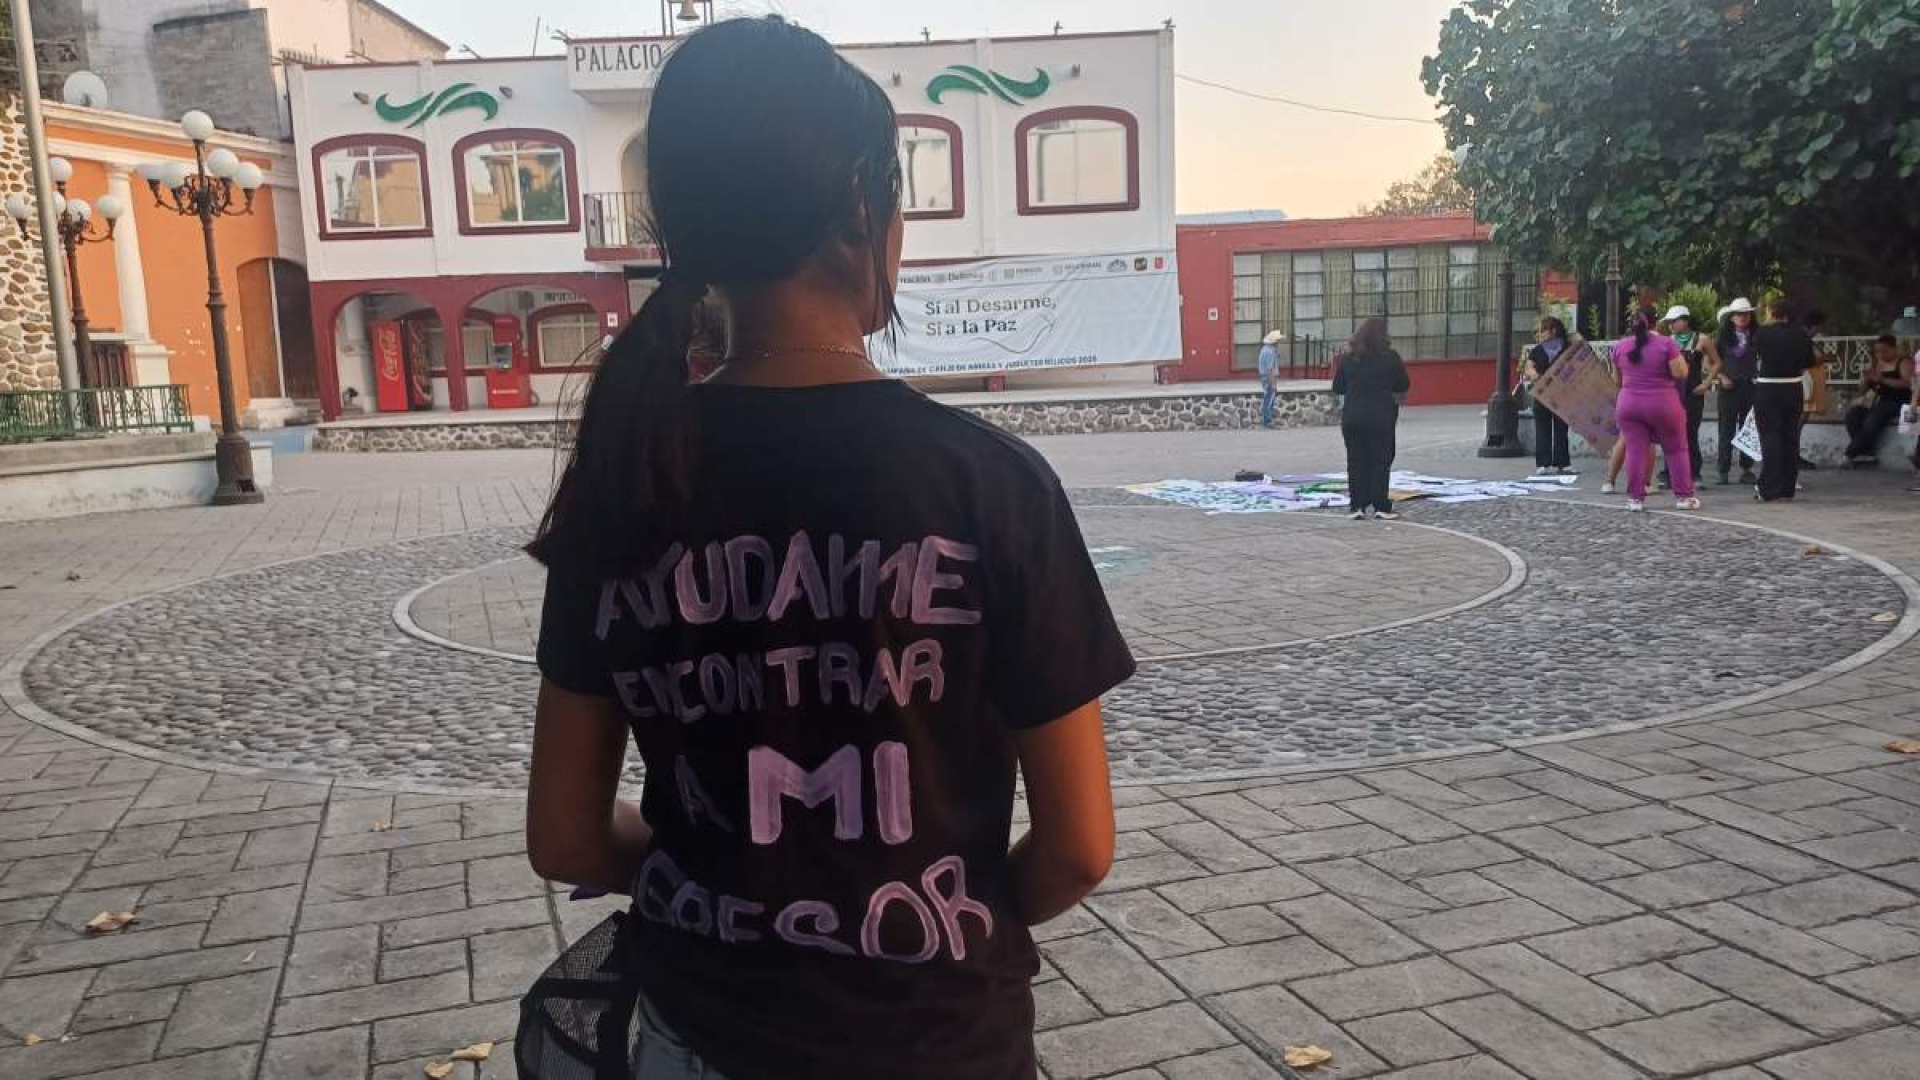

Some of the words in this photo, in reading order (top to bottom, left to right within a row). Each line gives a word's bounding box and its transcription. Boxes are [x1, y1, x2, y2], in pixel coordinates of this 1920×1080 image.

[574, 44, 662, 72] PALACIO
[945, 299, 960, 314] al
[967, 297, 1057, 313] Desarme,
[946, 324, 956, 335] a
[962, 319, 979, 334] la
[984, 319, 1017, 333] Paz
[595, 529, 983, 641] AYUDAME
[612, 638, 946, 725] ENCONTRAR
[674, 754, 736, 832] A
[747, 741, 913, 846] MI
